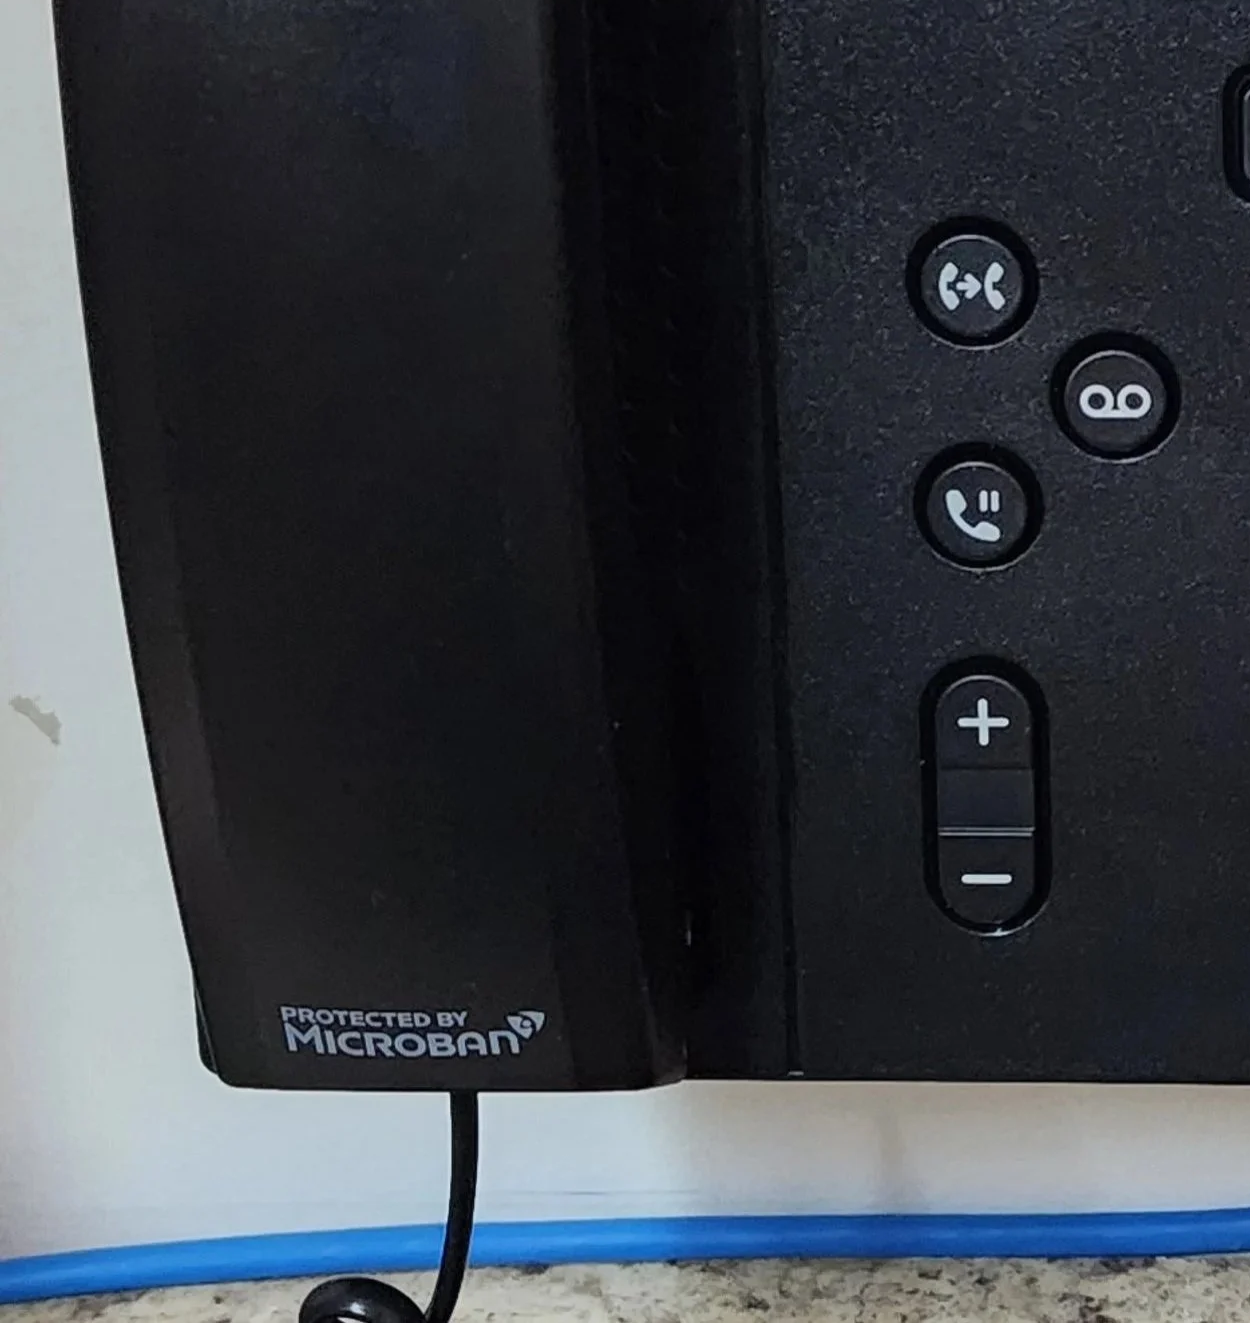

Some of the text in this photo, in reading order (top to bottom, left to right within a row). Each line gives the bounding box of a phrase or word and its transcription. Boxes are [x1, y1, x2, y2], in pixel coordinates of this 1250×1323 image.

[279, 1005, 468, 1028] PROTECTED BY
[283, 1022, 521, 1057] MICROBAN
